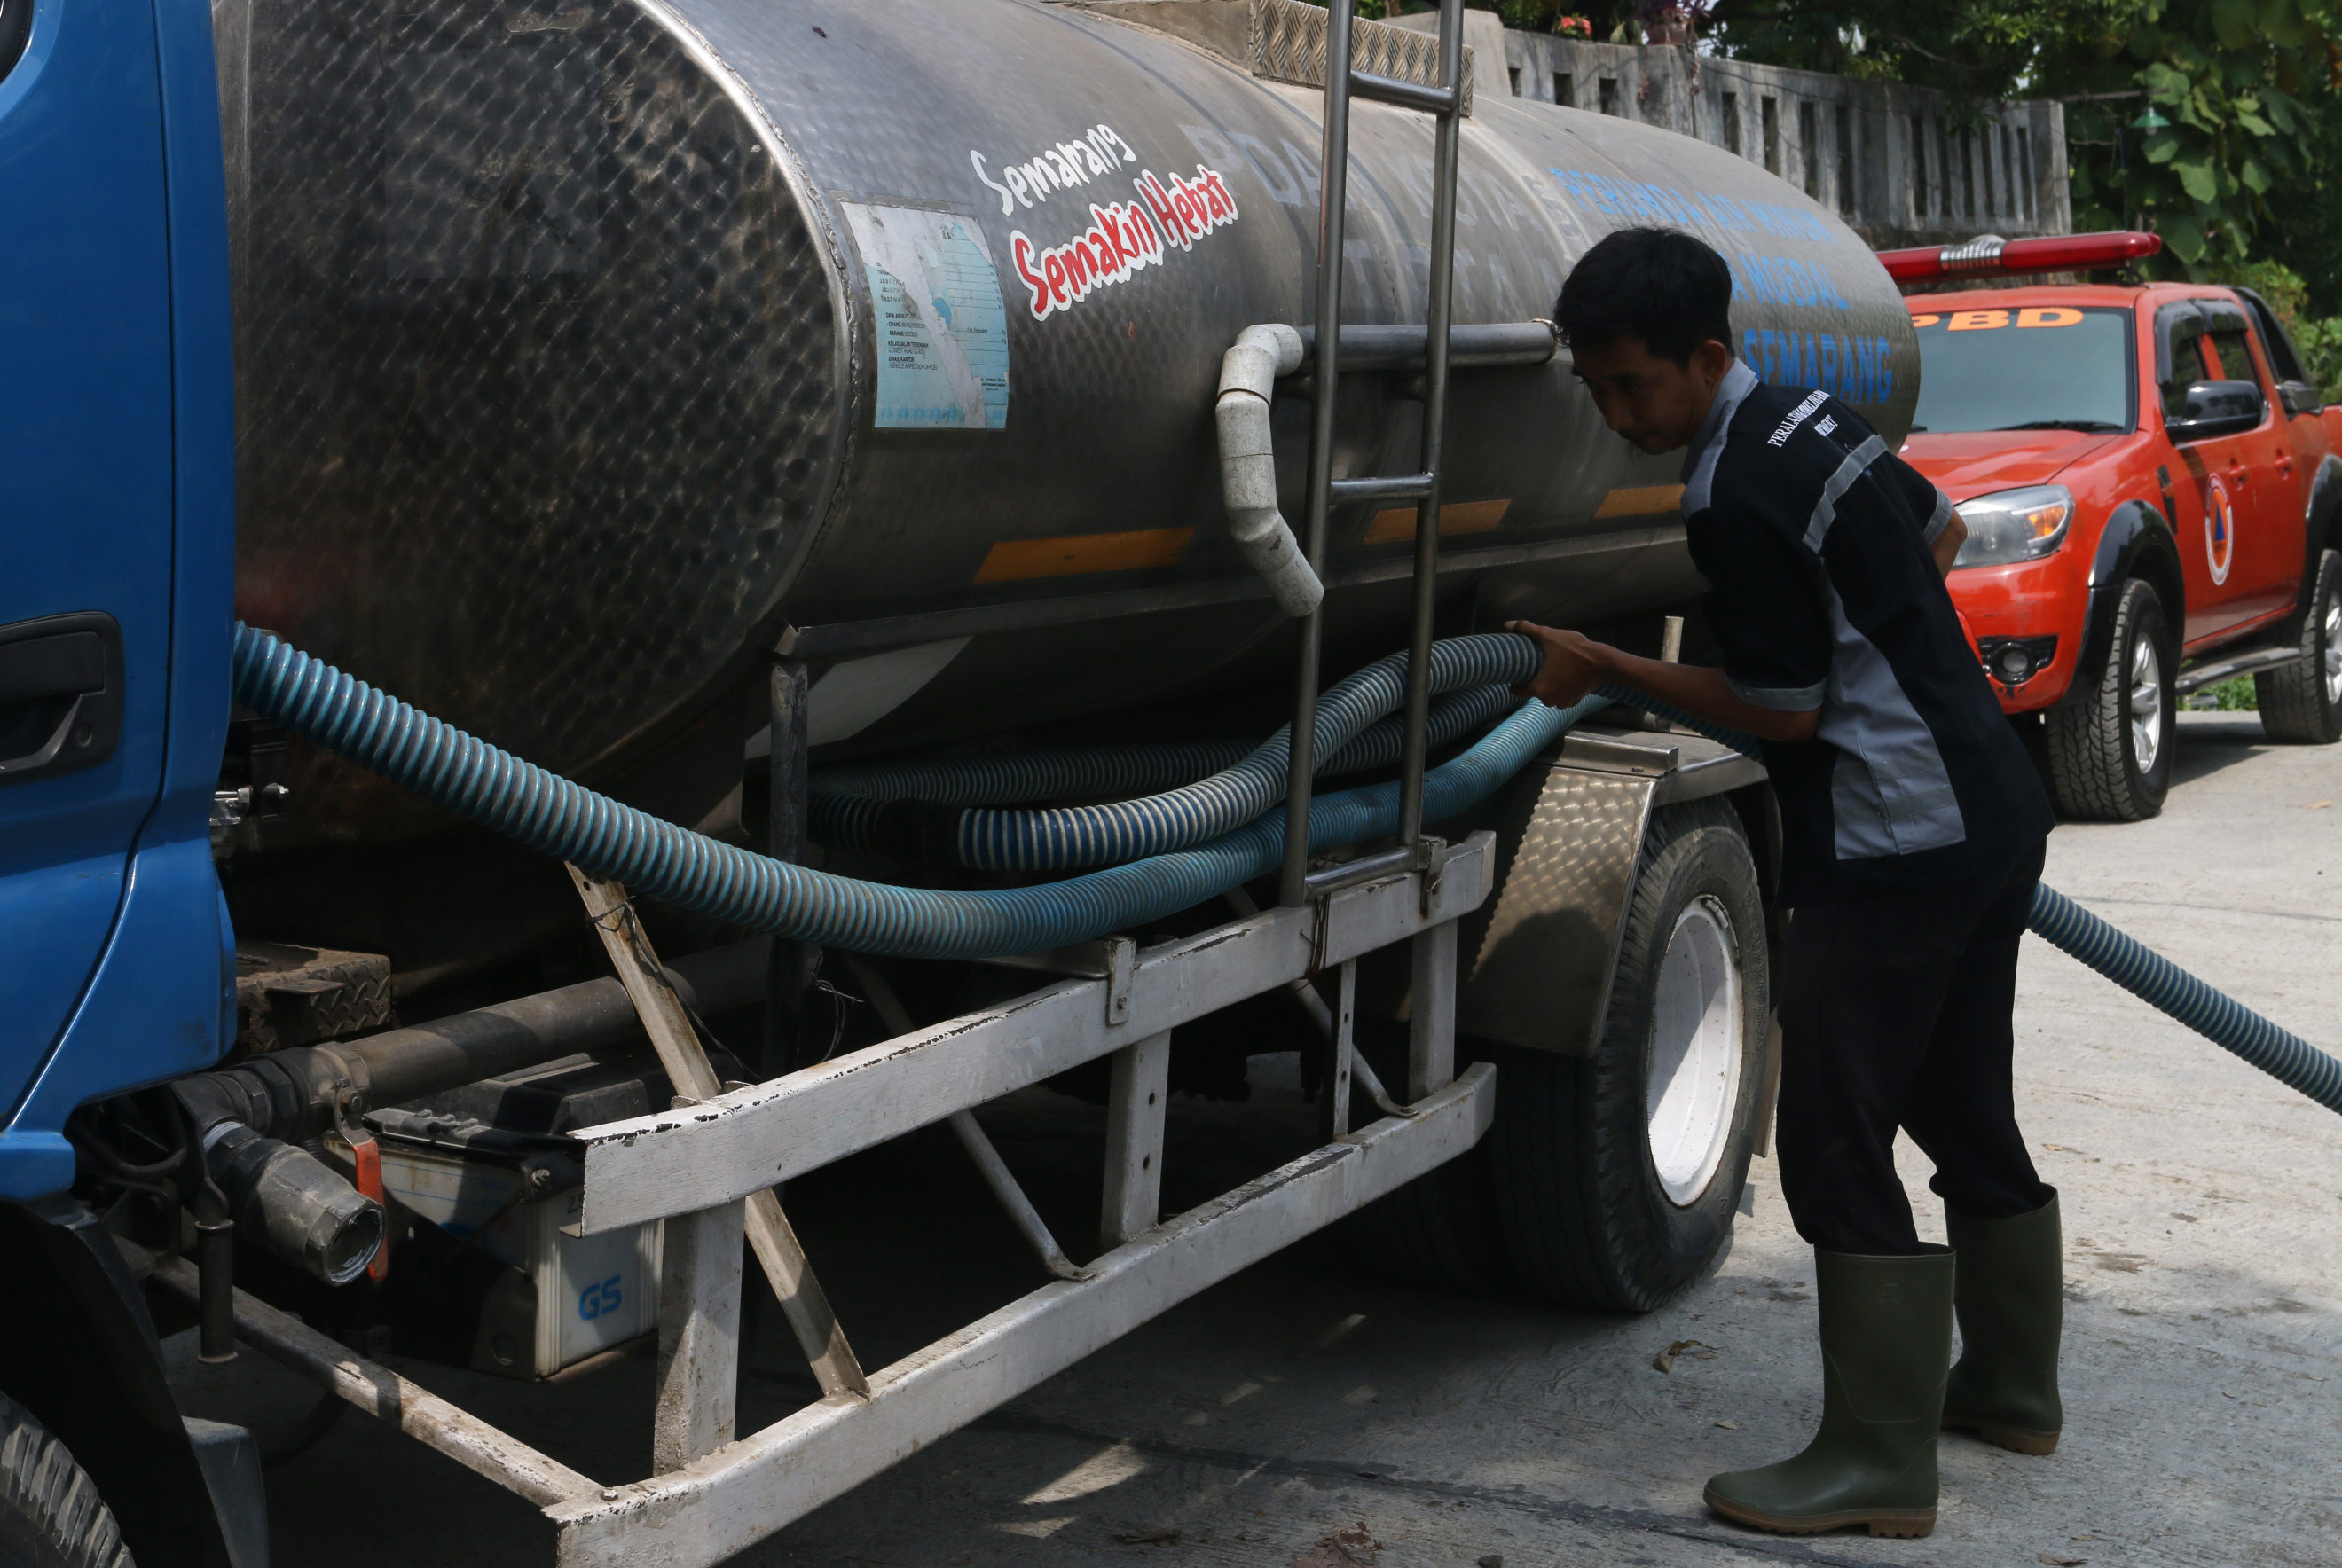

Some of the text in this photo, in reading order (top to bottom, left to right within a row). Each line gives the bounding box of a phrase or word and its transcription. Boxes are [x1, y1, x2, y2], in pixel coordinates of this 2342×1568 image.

[970, 124, 1136, 216] Semarang
[1134, 165, 1237, 251] Hebat
[1695, 191, 1760, 234] AIR
[1739, 254, 1850, 310] MOEDAL
[1743, 328, 1892, 404] SEMARANG
[578, 1274, 622, 1321] GS
